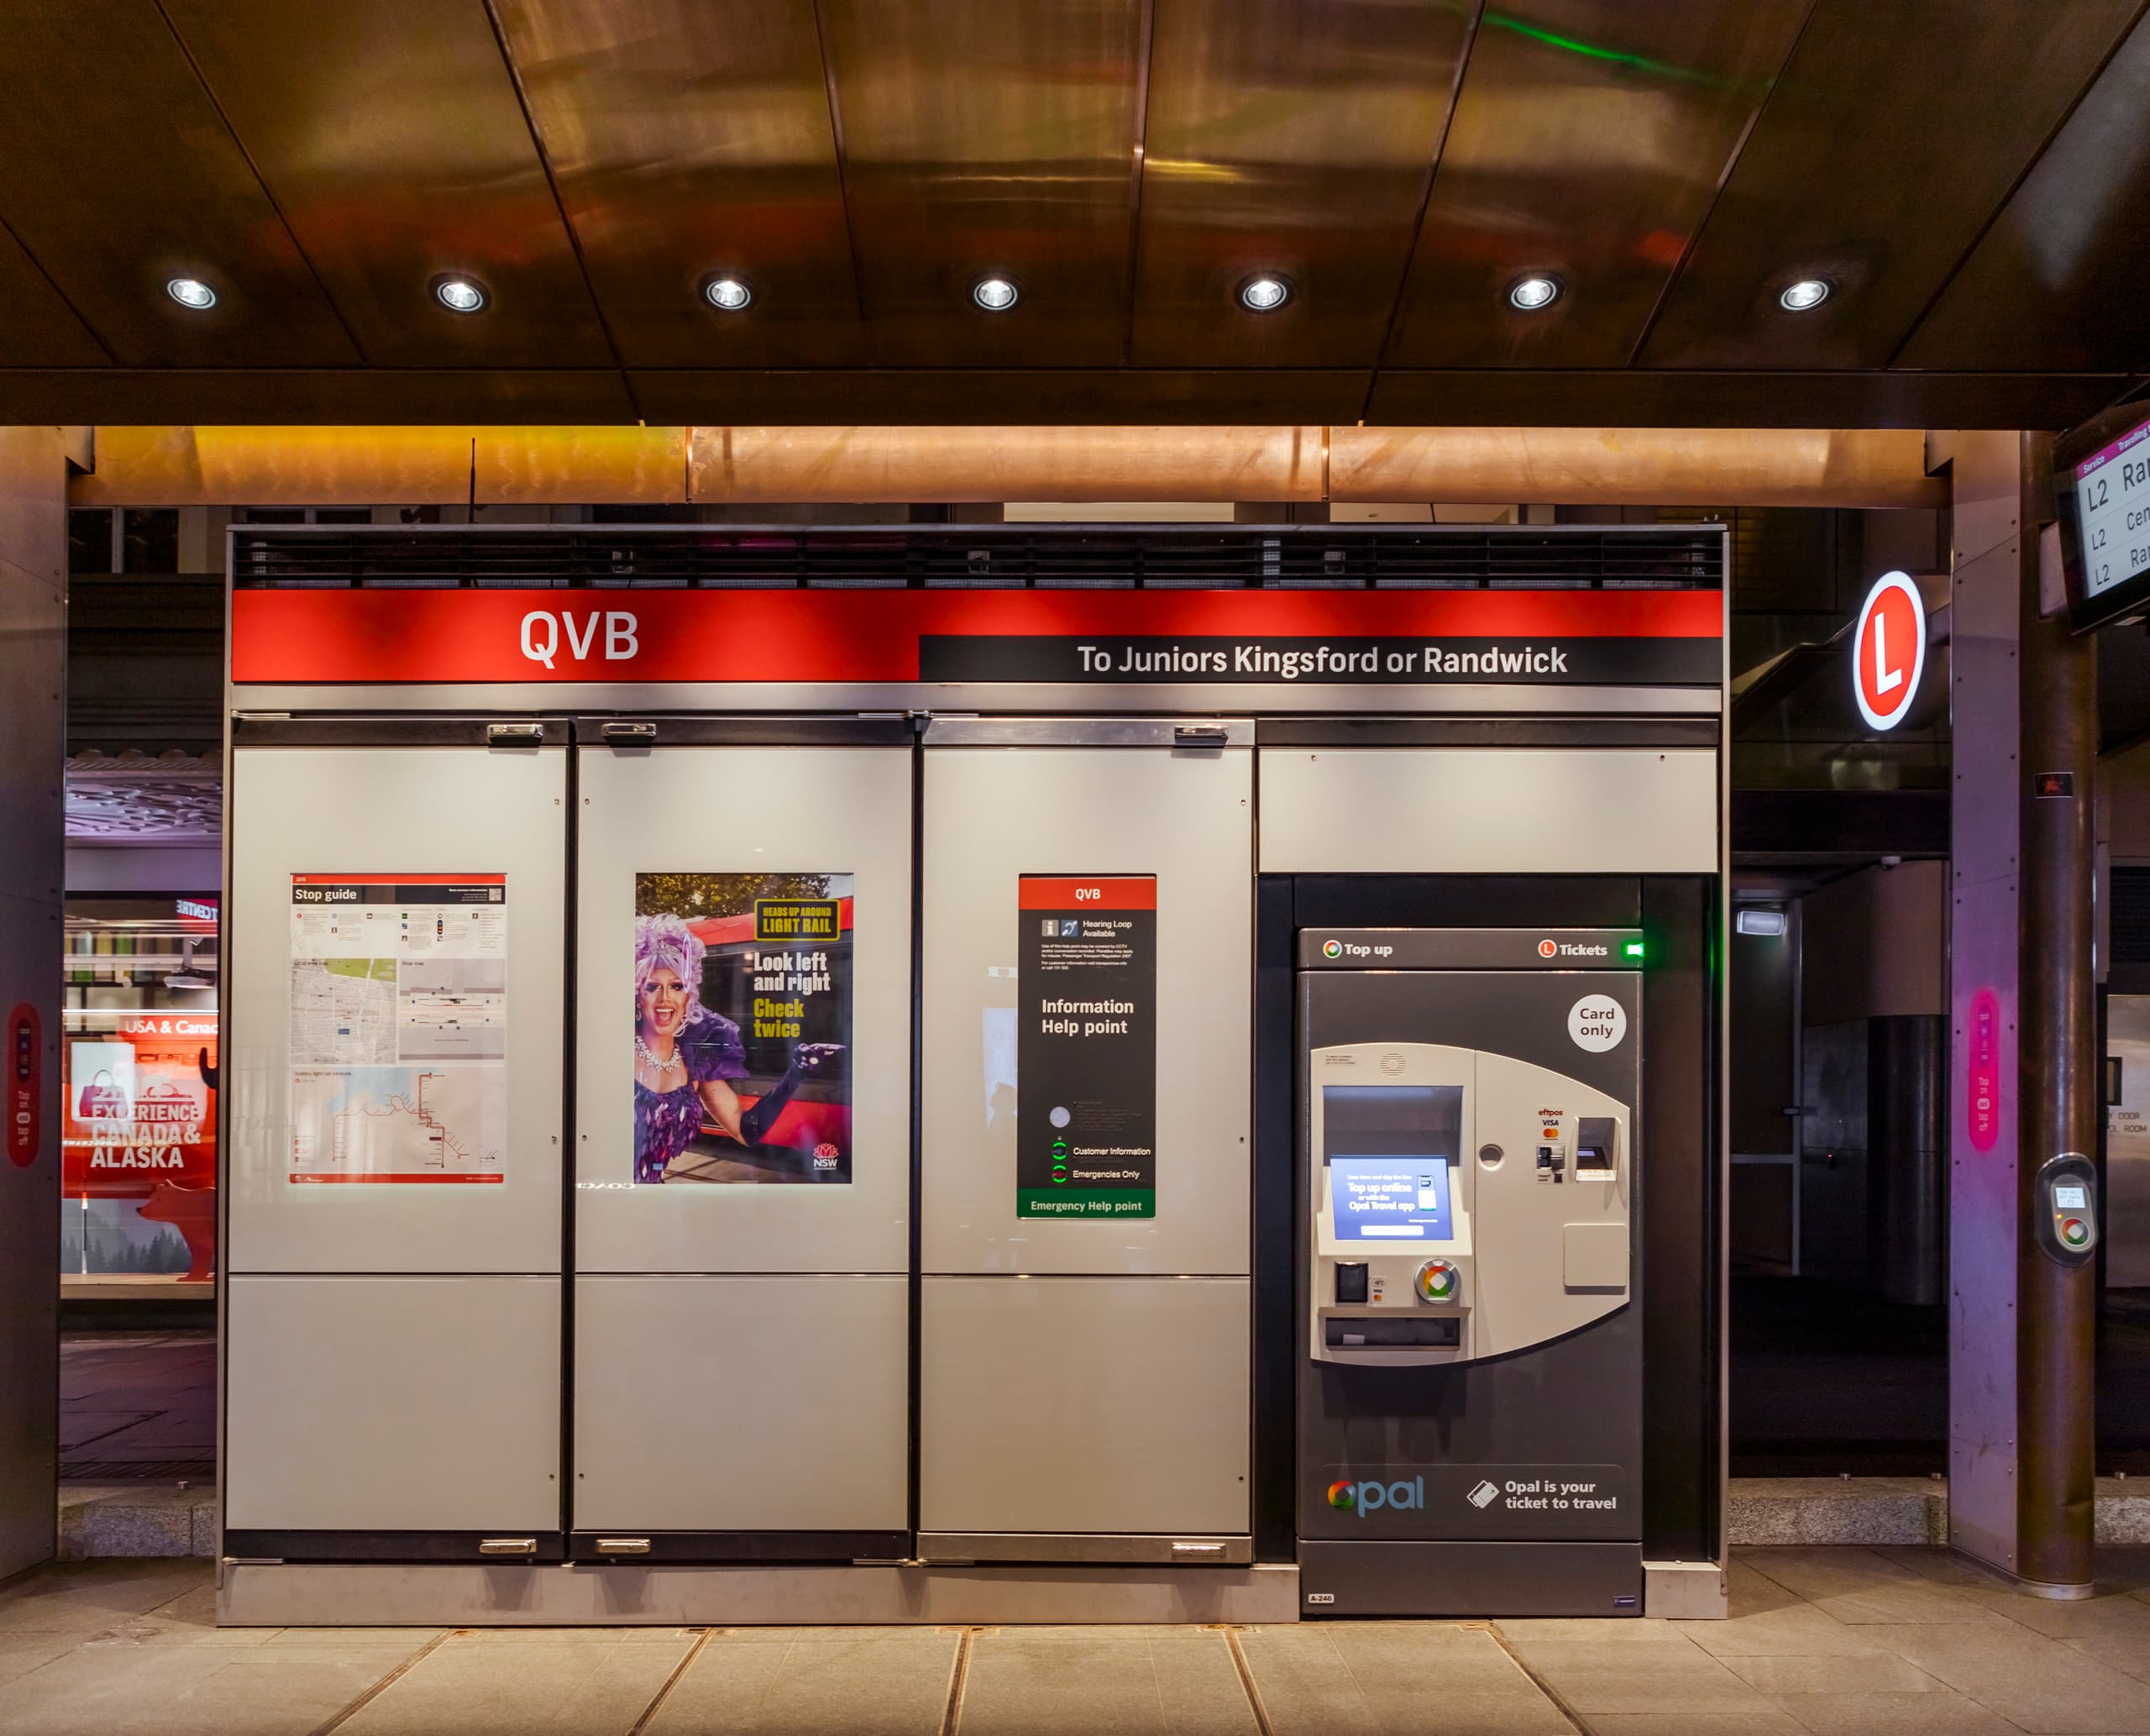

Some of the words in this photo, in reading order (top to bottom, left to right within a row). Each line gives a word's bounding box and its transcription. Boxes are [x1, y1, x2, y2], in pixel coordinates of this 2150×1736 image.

[2083, 455, 2105, 473] Service
[2117, 427, 2147, 451] Travelling
[2087, 479, 2109, 512] L2
[2122, 458, 2150, 491] Ra
[2091, 528, 2106, 551] L2
[2095, 564, 2110, 586] L2
[521, 611, 637, 669] QVB
[1874, 611, 1902, 696] L
[1078, 646, 1111, 672] To
[1119, 646, 1227, 672] Juniors
[1235, 646, 1377, 679] Kingsford
[1387, 653, 1418, 672] or
[1425, 646, 1567, 673] Randwick
[296, 889, 322, 902] Stop
[324, 889, 357, 902] guide
[1075, 888, 1101, 901] QVB
[763, 907, 788, 916] HEADS
[789, 907, 800, 916] UP
[800, 907, 831, 916] AROUND
[763, 918, 800, 933] LIGHT
[802, 918, 831, 933] RAIL
[1083, 920, 1112, 929] Hearing
[1113, 920, 1132, 929] Loop
[1345, 943, 1371, 957] Top
[1375, 947, 1393, 957] up
[1560, 943, 1607, 956] Tickets
[753, 951, 793, 972] Look
[796, 951, 827, 972] left
[753, 973, 784, 991] and
[787, 972, 831, 995] right
[753, 998, 805, 1018] Check
[1042, 999, 1134, 1014] Information
[1580, 1007, 1615, 1020] Card
[126, 1020, 157, 1034] USA
[160, 1020, 172, 1034] &
[753, 1019, 800, 1038] twice
[1042, 1019, 1079, 1036] Help
[1084, 1019, 1128, 1036] point
[1581, 1024, 1613, 1038] only
[92, 1104, 199, 1122] EXERIENCE
[1538, 1108, 1564, 1118] eftpos
[2118, 1112, 2141, 1120] DOOR
[92, 1123, 181, 1146] CANADA
[2124, 1125, 2147, 1133] ROOM
[90, 1146, 184, 1168] ALASKA
[1072, 1147, 1109, 1156] Customer
[1109, 1147, 1151, 1156] Information
[813, 1158, 838, 1167] NSW
[1072, 1170, 1121, 1180] Emergencies
[1122, 1170, 1141, 1180] Only
[1347, 1183, 1366, 1194] Top
[1366, 1184, 1381, 1194] up
[1381, 1182, 1412, 1192] online
[1030, 1201, 1086, 1213] Emergency
[1088, 1201, 1112, 1213] Help
[1114, 1201, 1142, 1213] point
[1349, 1201, 1371, 1212] Opal
[1371, 1201, 1398, 1210] Travel
[1398, 1204, 1415, 1212] app
[1505, 1480, 1540, 1495] Opal
[1544, 1480, 1557, 1492] is
[1561, 1483, 1597, 1495] your
[1505, 1496, 1549, 1509] ticket
[1552, 1497, 1569, 1509] to
[1573, 1497, 1617, 1509] travel
